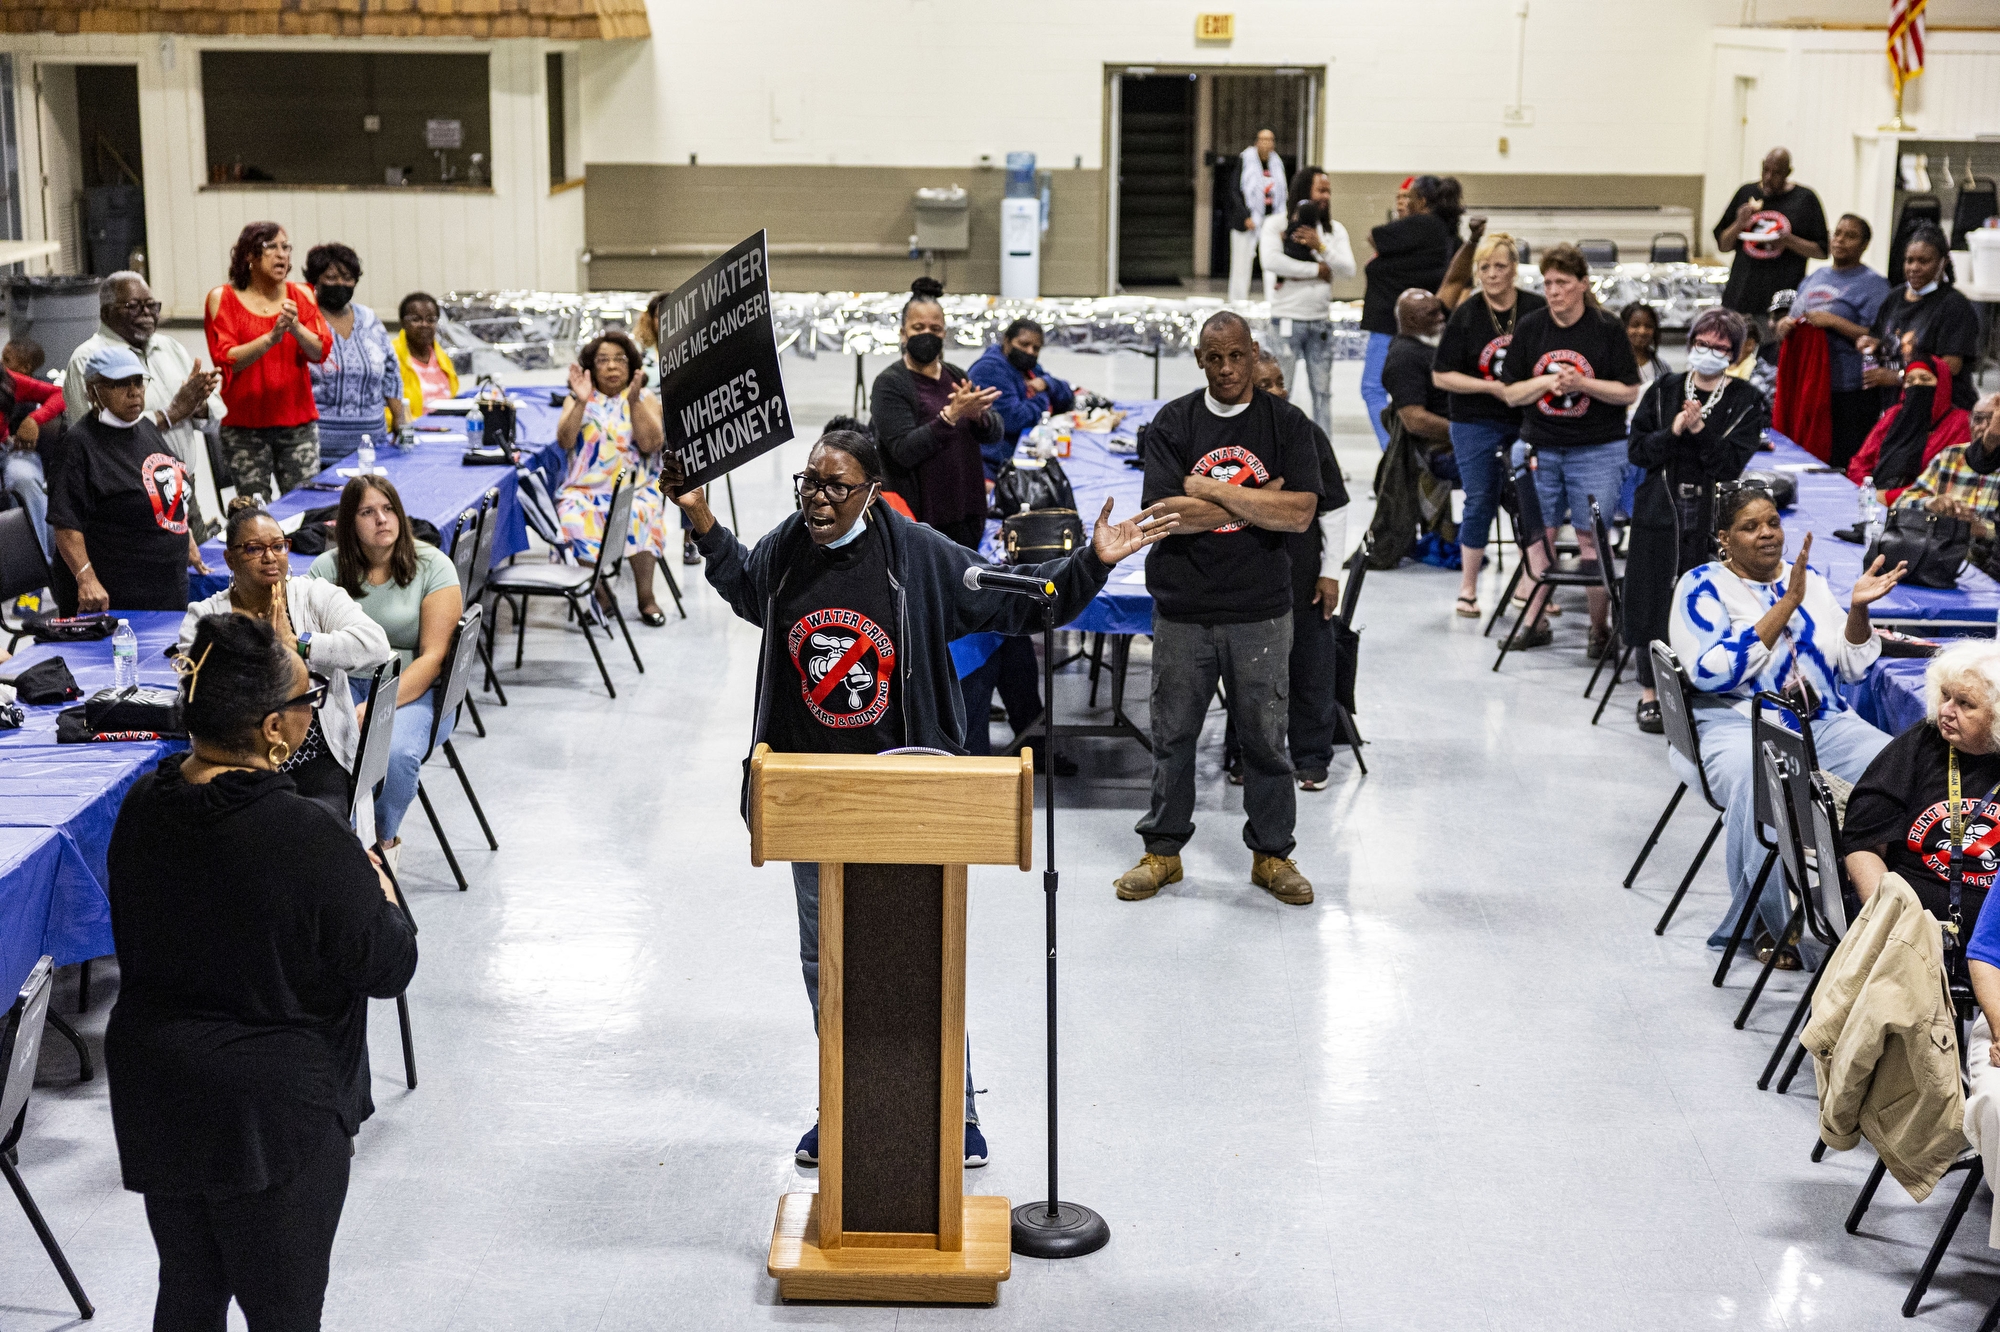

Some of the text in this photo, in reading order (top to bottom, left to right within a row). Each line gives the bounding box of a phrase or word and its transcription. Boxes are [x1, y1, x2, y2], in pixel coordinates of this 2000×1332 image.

[660, 247, 763, 344] FLINT WATER
[660, 289, 768, 378] GAVE ME CANCER!
[680, 368, 760, 438] WHERE'S
[706, 395, 784, 464] MONEY?
[806, 610, 860, 628] WATER
[860, 620, 894, 658] CRISIS
[805, 694, 835, 725] YEARS
[838, 717, 846, 727] &
[847, 680, 888, 726] COUNTING
[1908, 806, 1941, 843] FLINT
